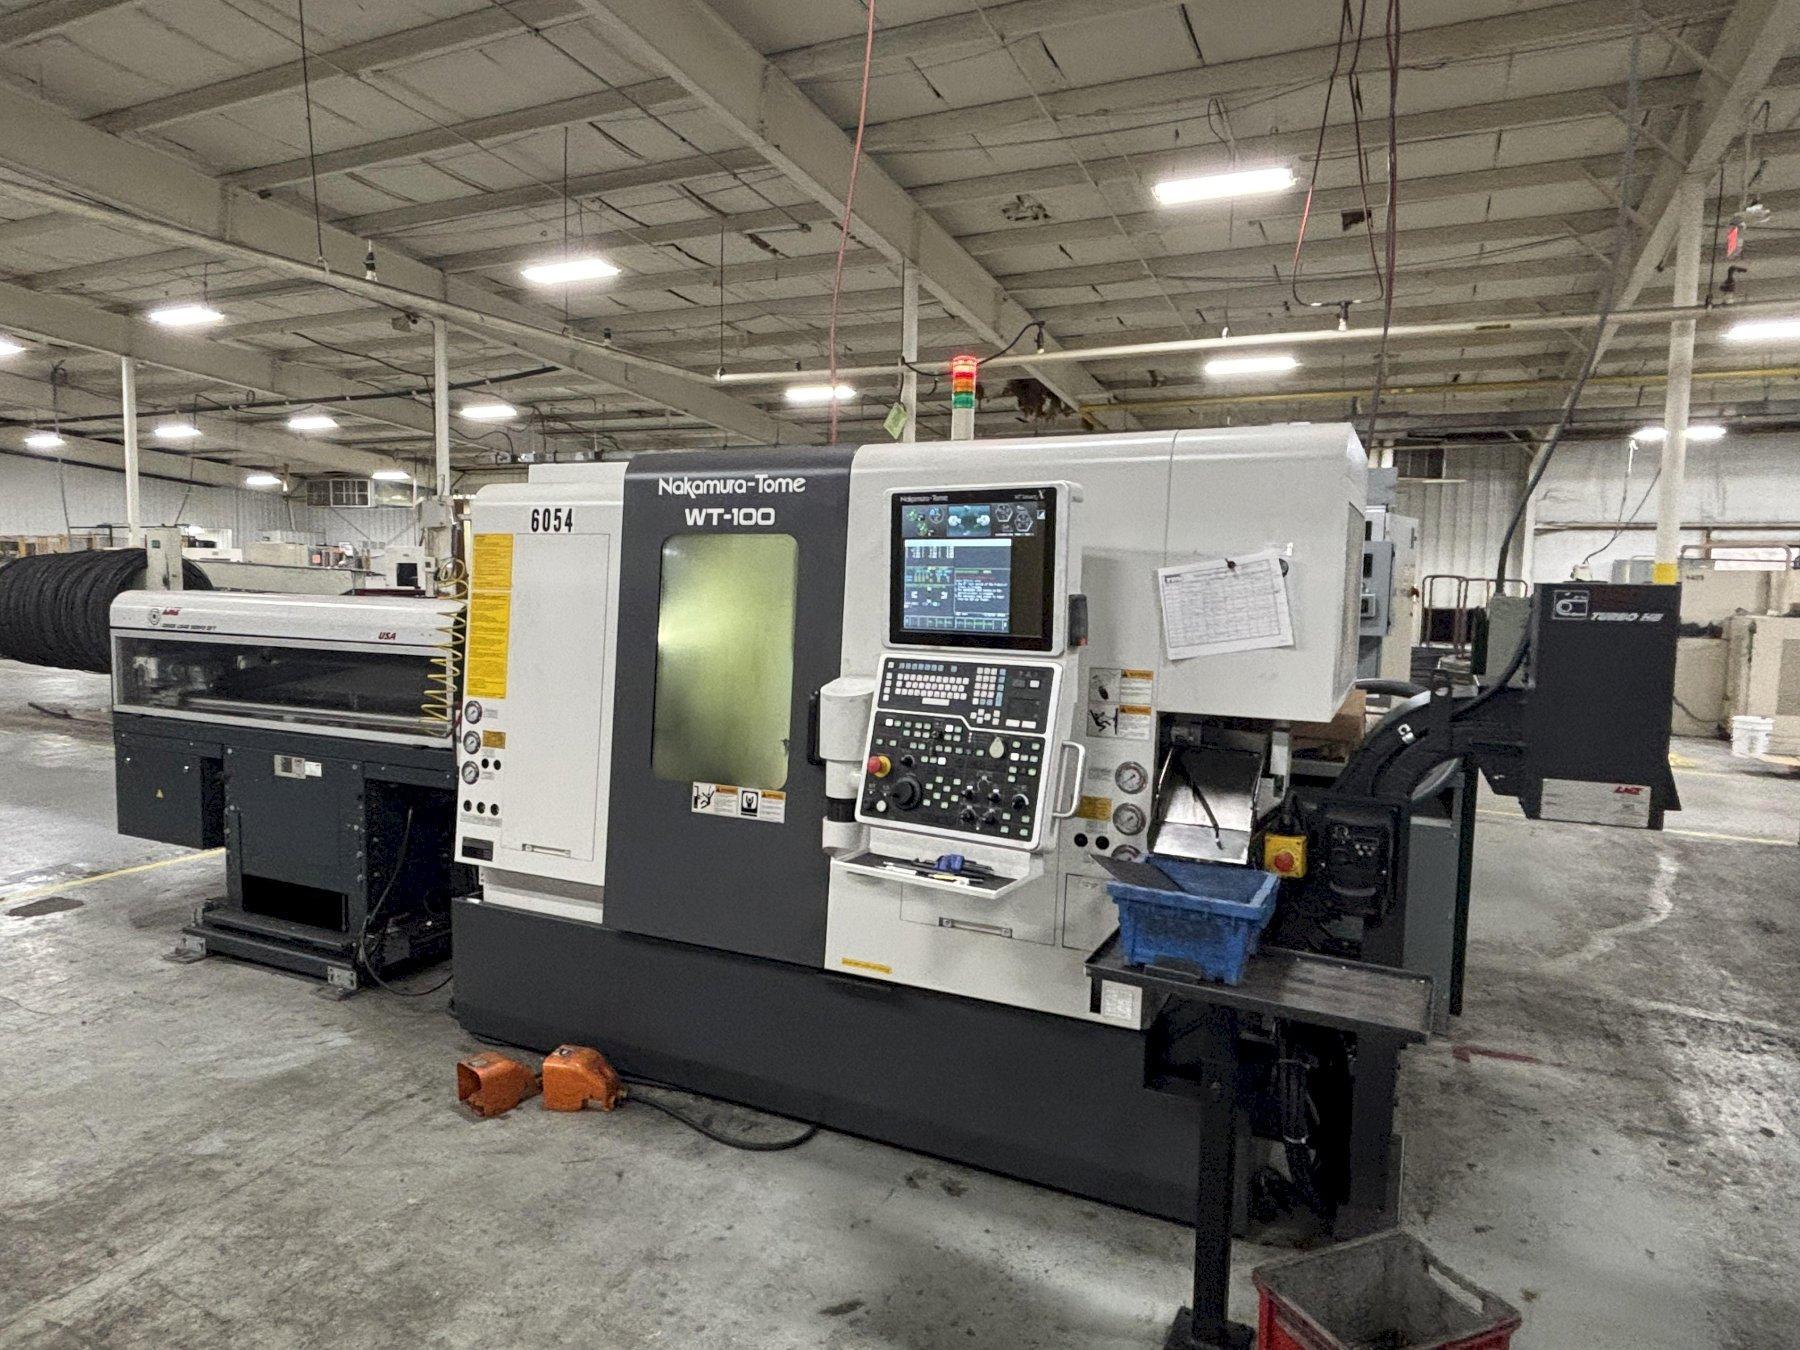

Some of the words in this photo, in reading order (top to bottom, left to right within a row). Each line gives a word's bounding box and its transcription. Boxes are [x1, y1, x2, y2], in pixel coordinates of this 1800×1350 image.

[658, 474, 807, 499] Nakamura-Tome
[531, 507, 573, 533] 6054
[684, 507, 776, 526] WT-100
[378, 631, 397, 640] USA
